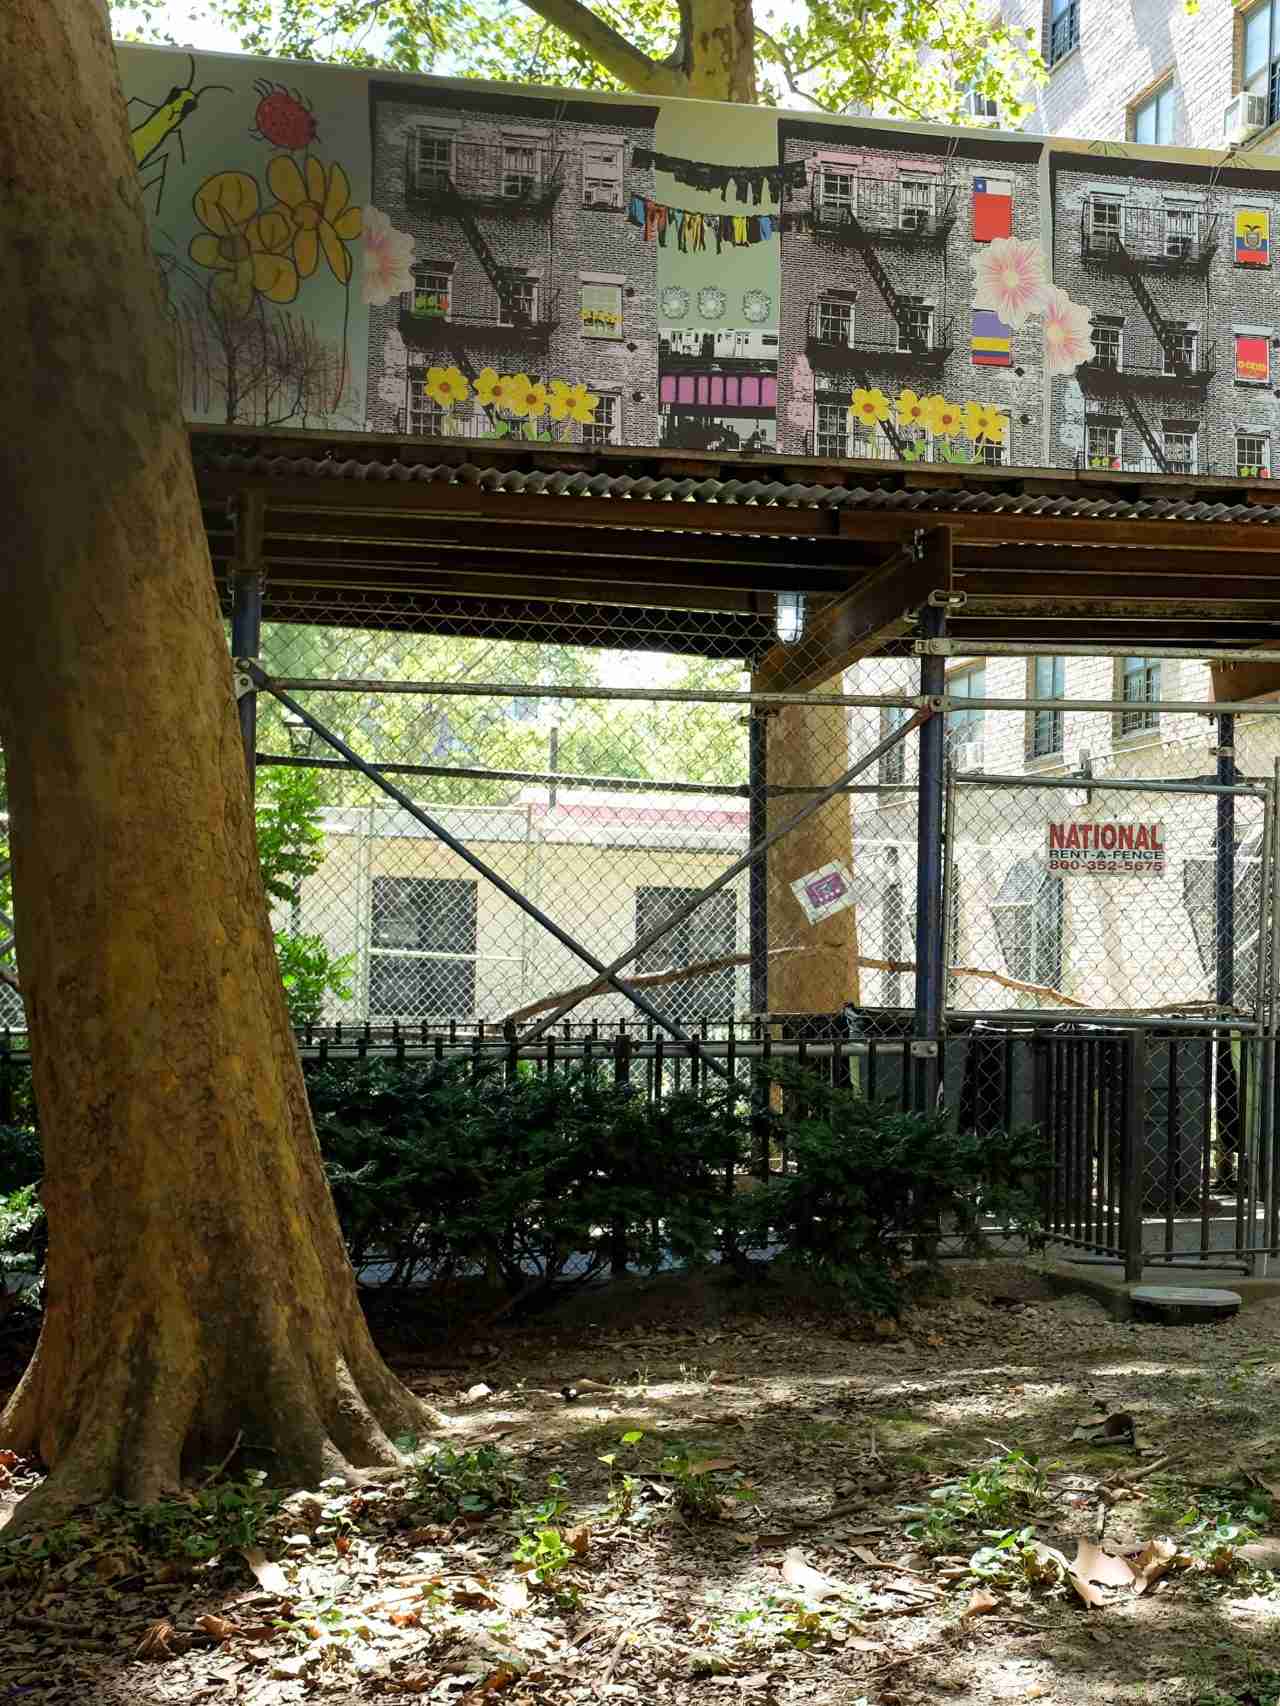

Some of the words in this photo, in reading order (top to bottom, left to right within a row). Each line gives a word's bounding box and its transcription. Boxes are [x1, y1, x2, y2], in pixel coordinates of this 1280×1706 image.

[1049, 823, 1164, 850] NATIONAL
[1049, 849, 1165, 860] RENT-A-FENCE
[1050, 860, 1163, 872] 800-352-5675
